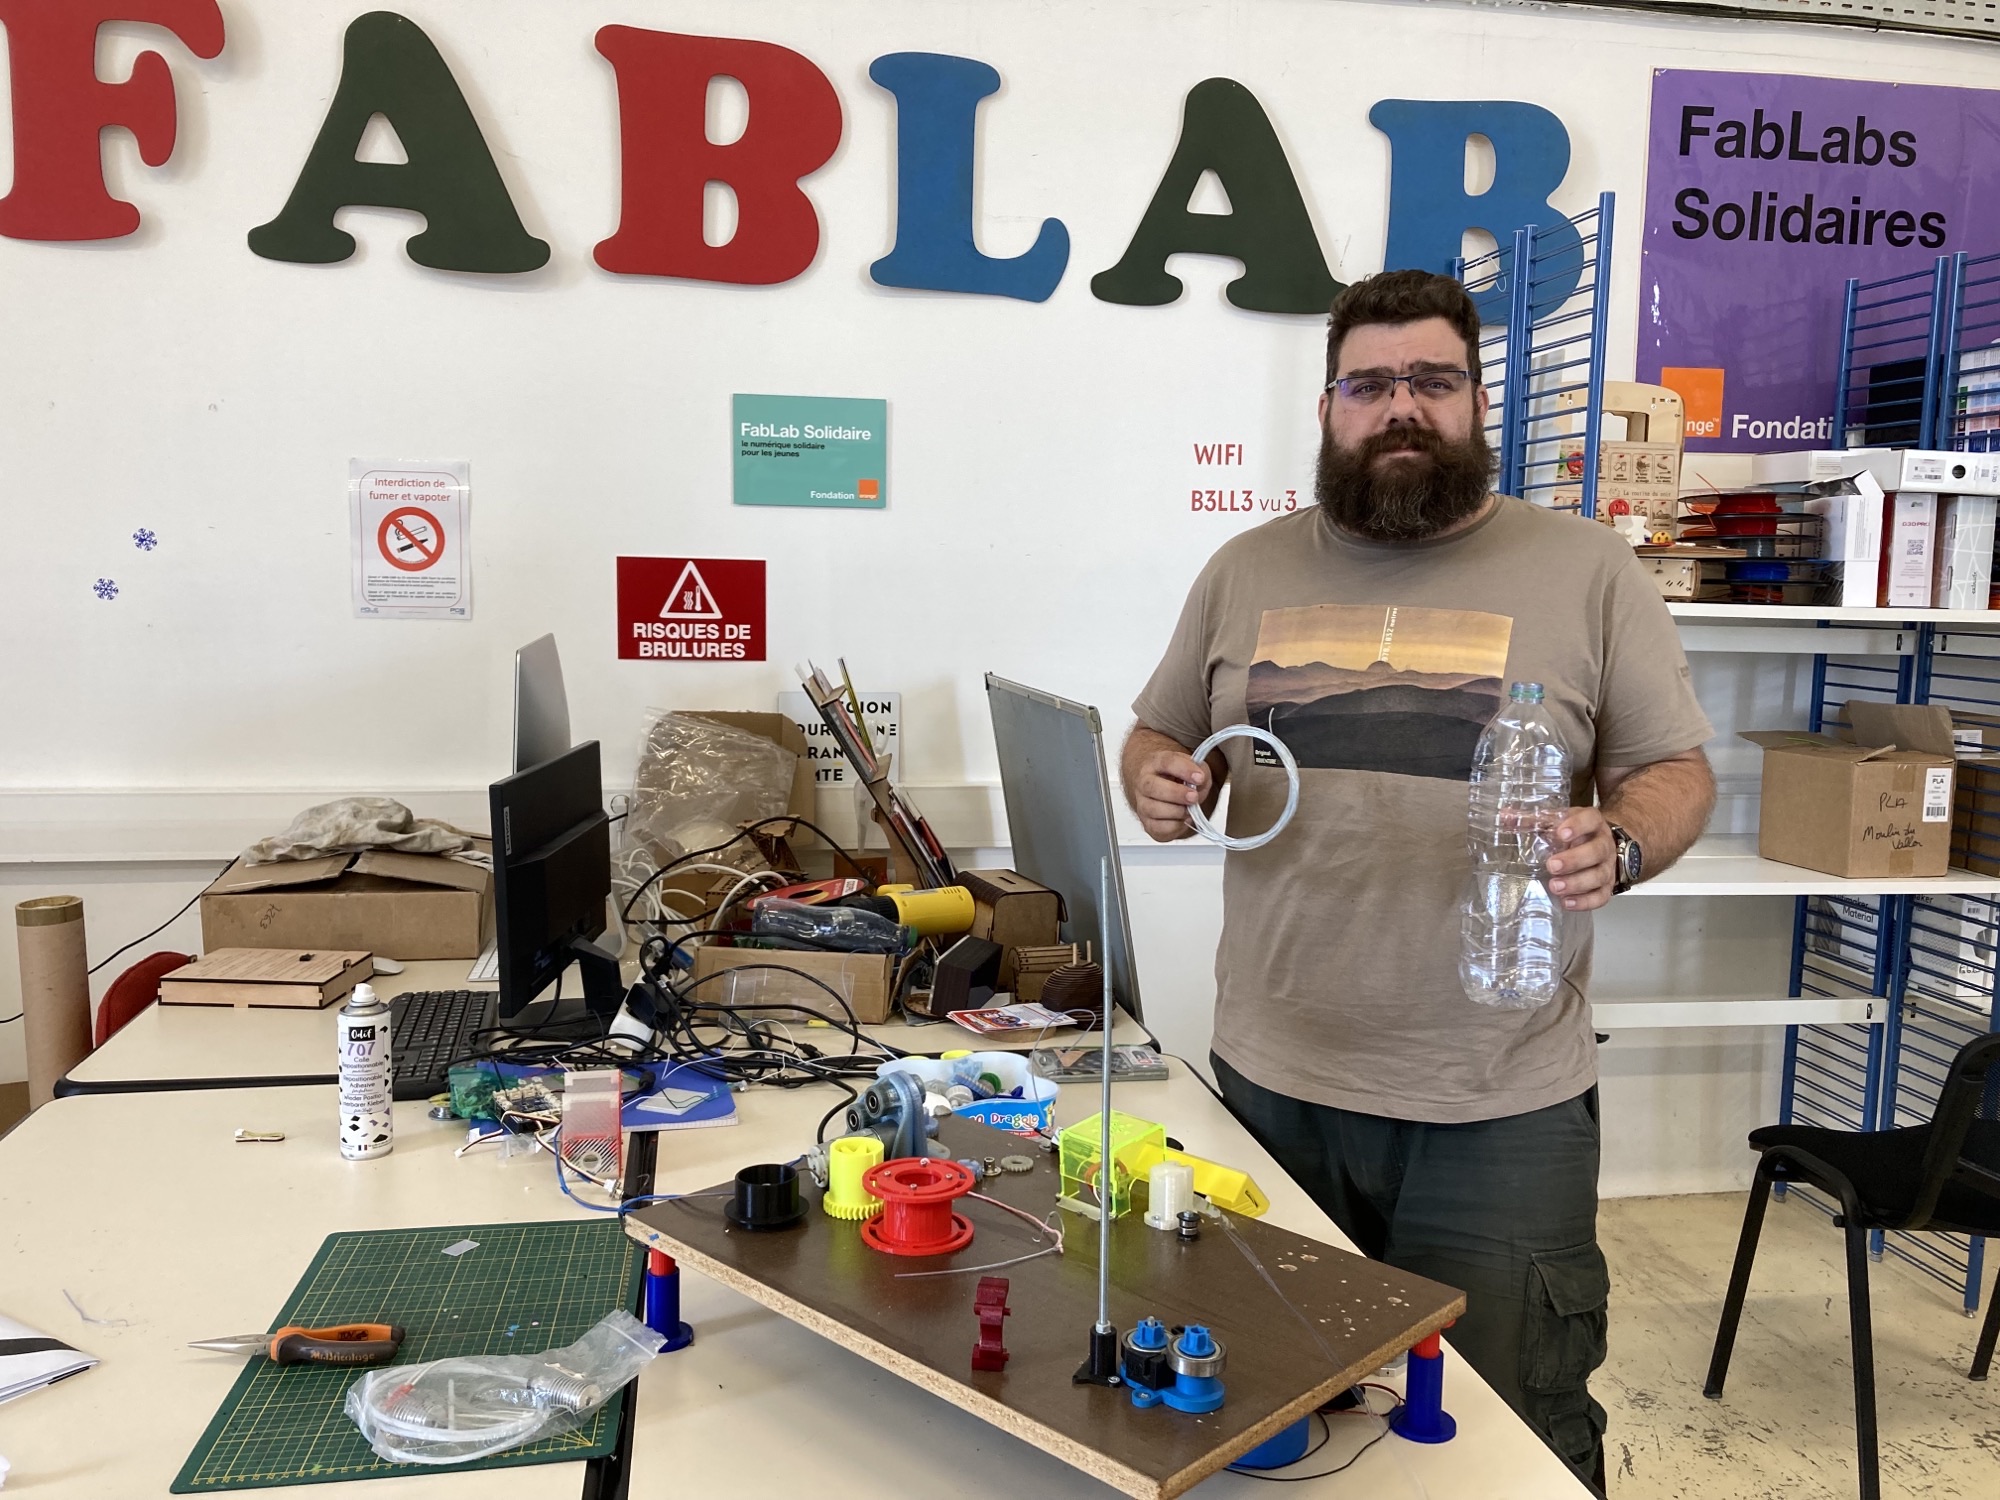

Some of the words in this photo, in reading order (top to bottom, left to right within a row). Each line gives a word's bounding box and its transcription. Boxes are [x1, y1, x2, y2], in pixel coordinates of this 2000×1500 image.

[1679, 104, 1917, 168] FabLabs
[1671, 187, 1947, 249] Solidaires
[741, 422, 800, 439] FabLab
[803, 424, 872, 441] Solidaire
[741, 449, 760, 457] pour
[761, 449, 772, 457] les
[773, 449, 800, 458] jeunes
[750, 440, 792, 450] numérique
[793, 441, 825, 450] solidaire
[1193, 443, 1243, 466] WIFI
[374, 477, 431, 488] Interdiction
[433, 479, 446, 488] de
[369, 490, 399, 501] fumer
[401, 491, 412, 501] et
[414, 493, 452, 503] vapoter
[810, 490, 855, 500] Fondation
[1191, 489, 1254, 512] B3LL3
[633, 622, 720, 639] RISQUES
[725, 624, 752, 640] DE
[639, 641, 746, 658] BRULURES
[1880, 792, 1908, 812] PLA
[1842, 906, 1874, 924] Material
[350, 1028, 373, 1040] Odif
[347, 1042, 376, 1057] 707
